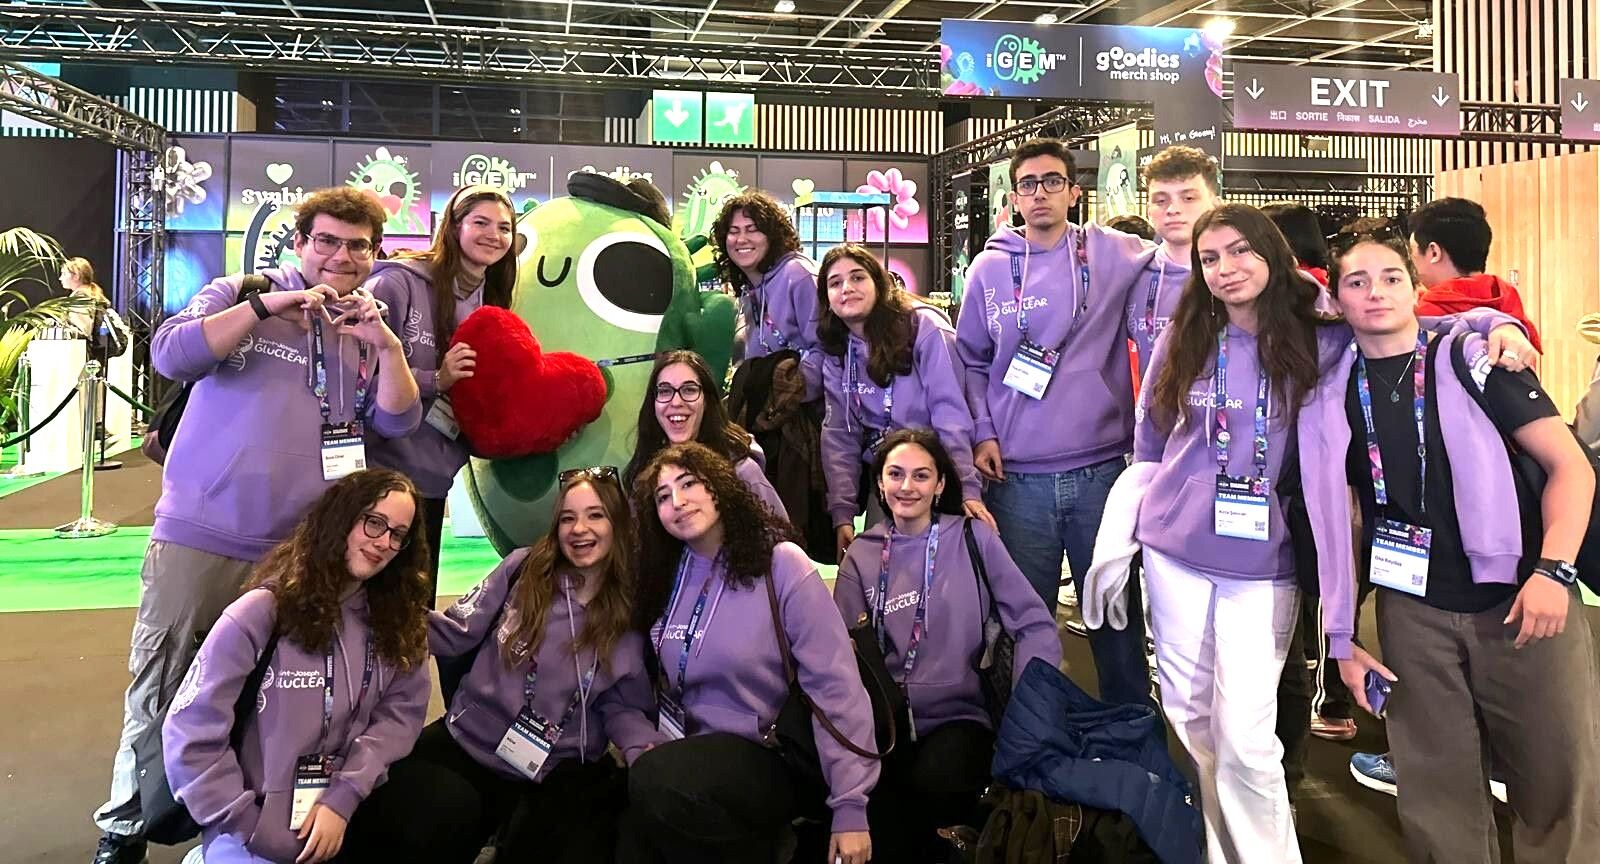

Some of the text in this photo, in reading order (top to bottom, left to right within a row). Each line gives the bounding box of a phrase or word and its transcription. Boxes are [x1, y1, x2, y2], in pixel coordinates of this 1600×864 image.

[1095, 46, 1180, 71] goodies
[1110, 69, 1180, 84] merch shop
[1310, 77, 1390, 108] EXIT
[1270, 110, 1287, 121] 出口
[1295, 111, 1329, 122] SORTIE
[1368, 115, 1400, 125] SALIDA
[1407, 118, 1428, 128] مخرج
[1218, 492, 1266, 503] TEAM MEMBER
[1375, 537, 1427, 555] TEAM MEMBER
[514, 721, 530, 735] TEAM
[528, 731, 551, 749] MEMBER
